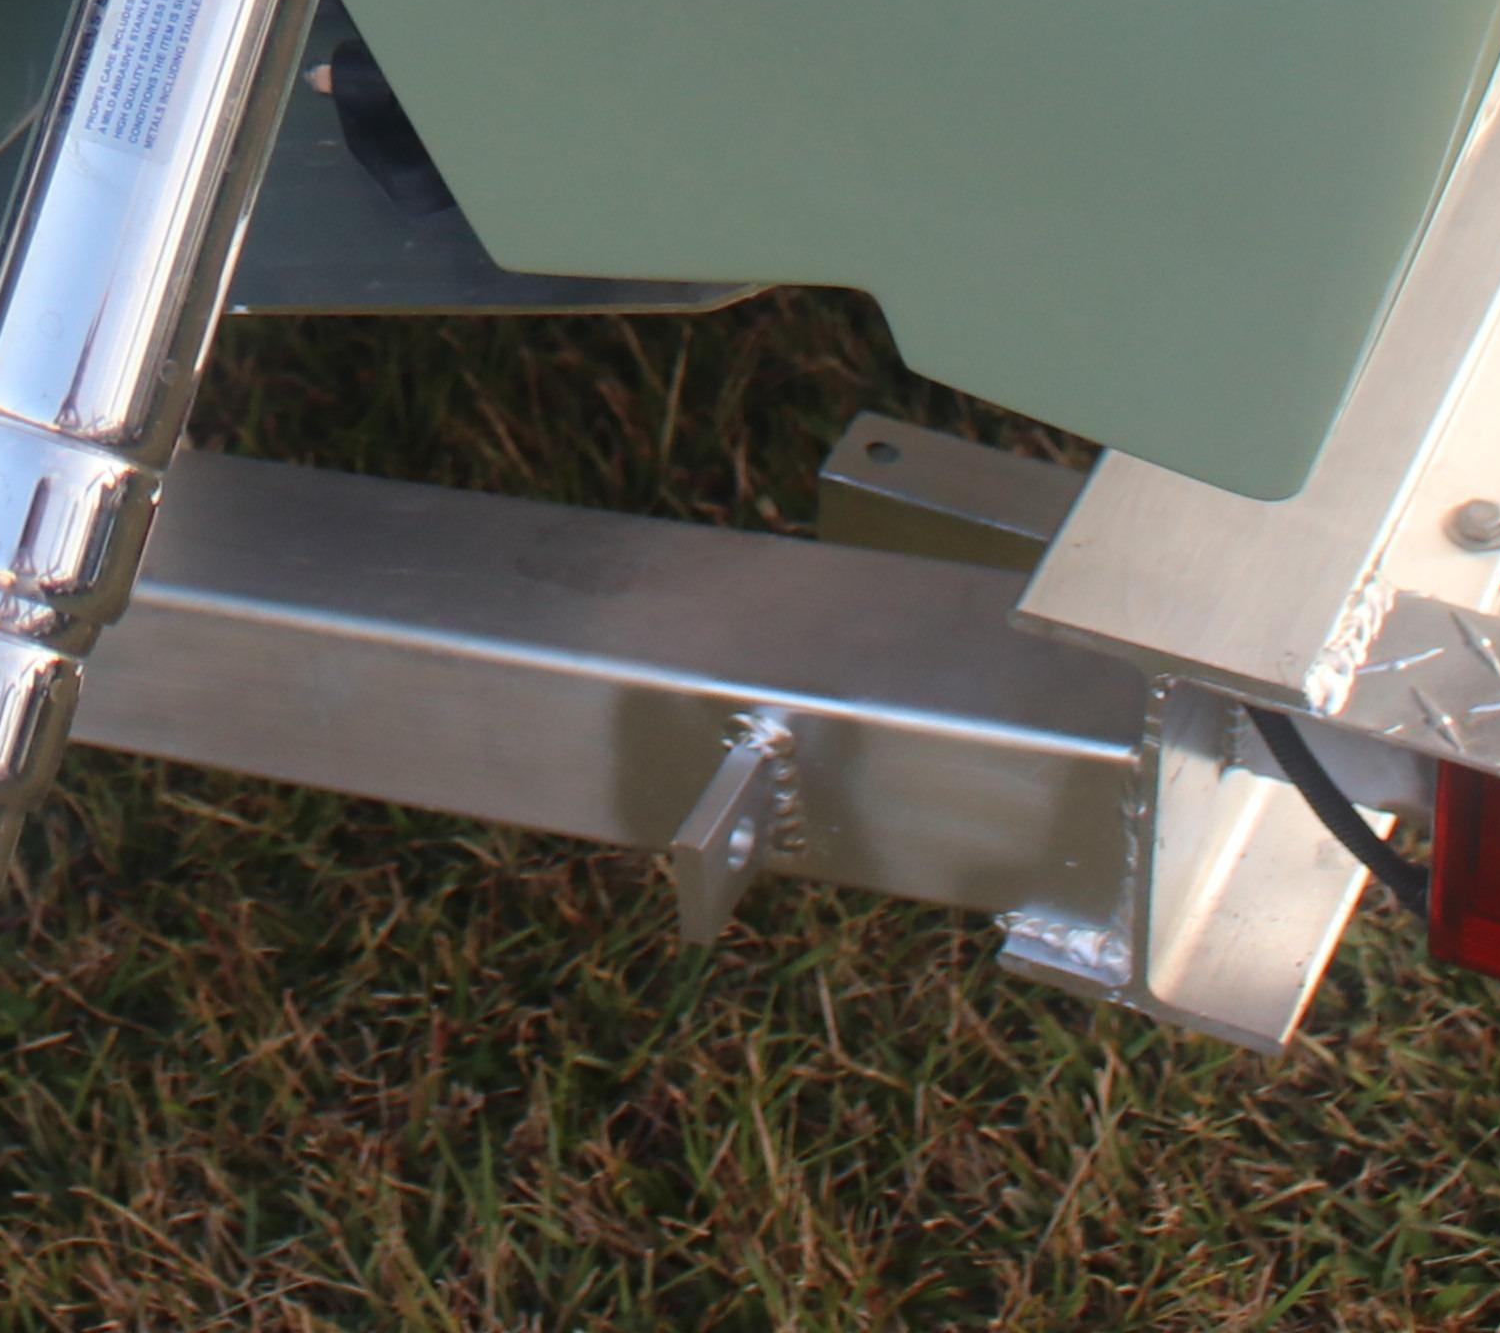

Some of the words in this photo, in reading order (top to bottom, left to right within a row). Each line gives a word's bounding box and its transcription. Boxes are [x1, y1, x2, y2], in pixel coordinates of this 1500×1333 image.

[158, 23, 176, 51] ITEM
[167, 11, 179, 23] IS
[109, 43, 135, 98] ABRASIVE
[122, 59, 147, 111] QUALITY
[138, 3, 166, 61] STAINLESS
[151, 53, 166, 74] THE
[158, 44, 186, 105] INCLUDING
[83, 84, 107, 130] PROPER
[99, 51, 118, 84] CARE
[127, 75, 158, 144] CONDITIONS
